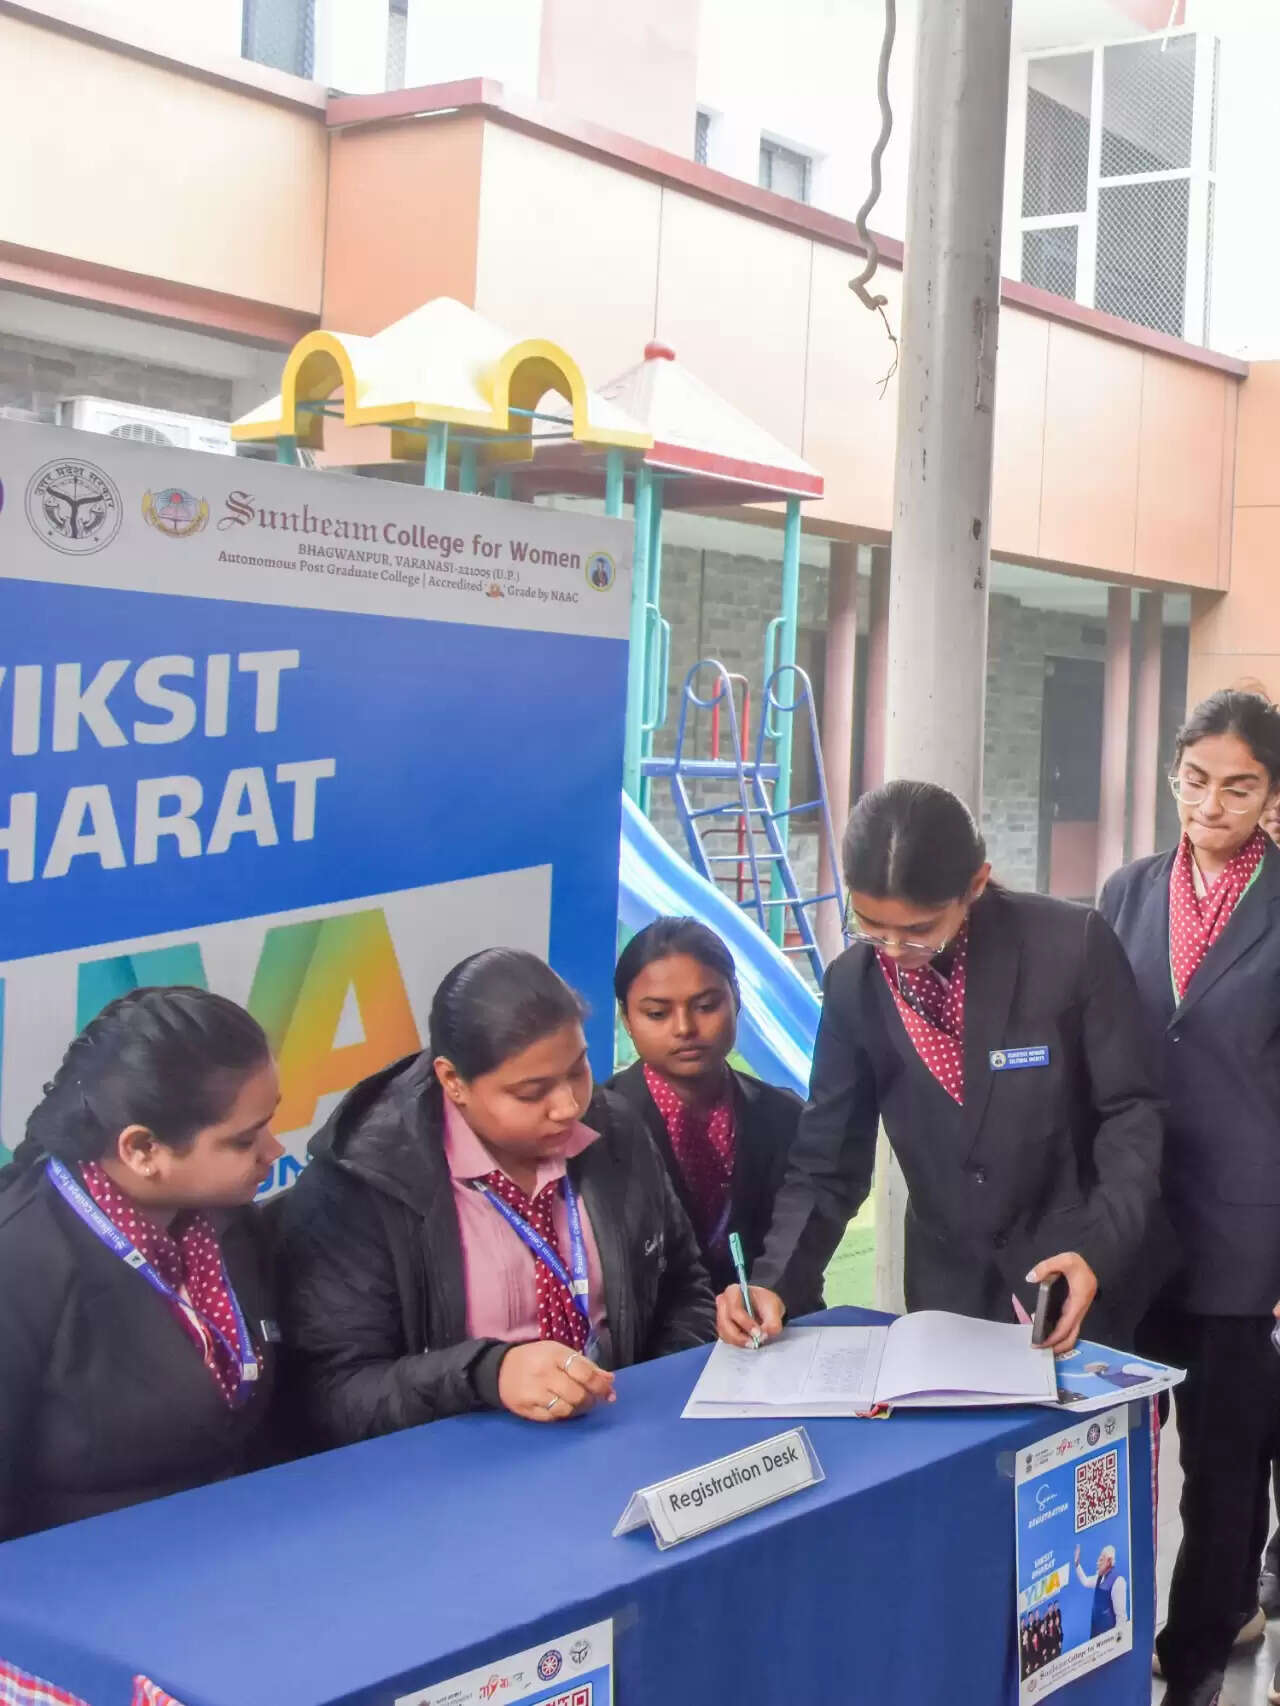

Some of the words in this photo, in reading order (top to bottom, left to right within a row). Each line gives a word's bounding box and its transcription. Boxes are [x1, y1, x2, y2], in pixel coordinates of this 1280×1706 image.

[216, 490, 378, 543] Sunbeam
[382, 522, 465, 558] College
[472, 534, 502, 559] for
[510, 540, 581, 570] Women
[218, 551, 296, 570] Autonomous
[300, 560, 325, 573] Post
[327, 564, 379, 580] Graduate
[380, 569, 420, 588] College
[428, 575, 482, 592] Accredited
[507, 586, 536, 599] Grade
[538, 588, 549, 602] by
[551, 591, 579, 603] NAAC
[0, 649, 299, 756] IKSIT
[668, 1463, 761, 1512] Registration
[762, 1446, 798, 1473] Desk
